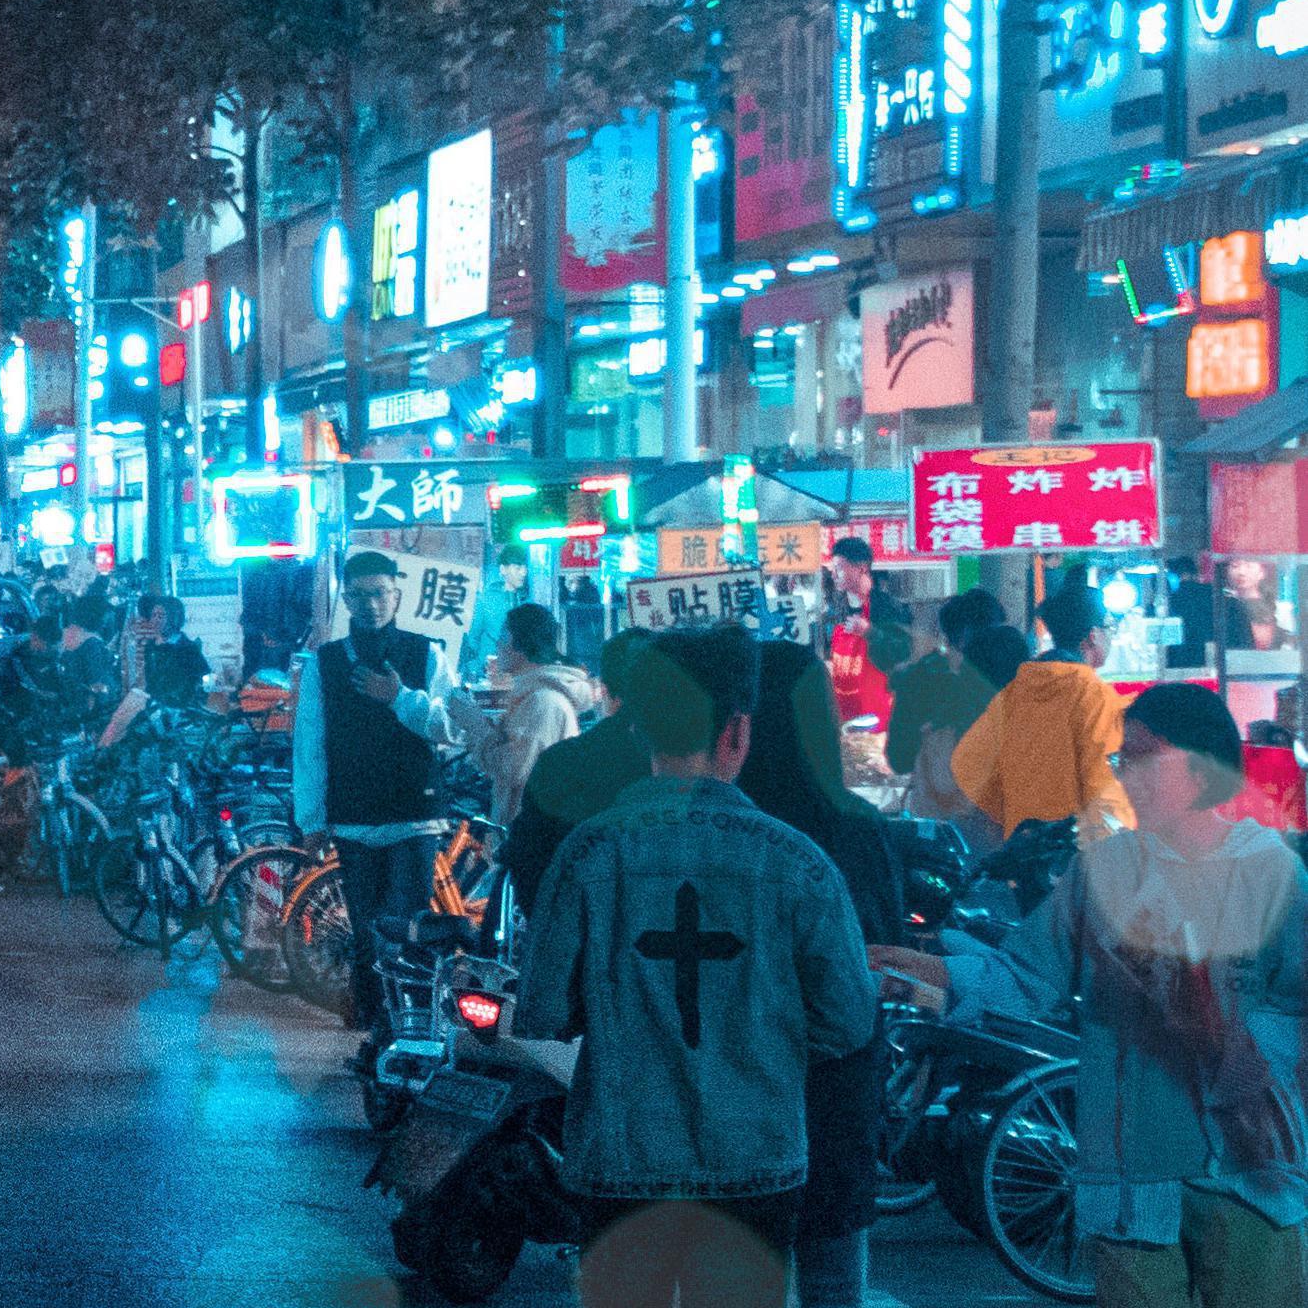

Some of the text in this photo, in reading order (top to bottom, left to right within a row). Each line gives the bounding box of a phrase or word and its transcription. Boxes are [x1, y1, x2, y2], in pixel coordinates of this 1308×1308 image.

[927, 471, 984, 551] 布袋馍
[1007, 468, 1064, 547] 炸串
[1087, 467, 1146, 545] 炸饼
[396, 563, 470, 629] 膜
